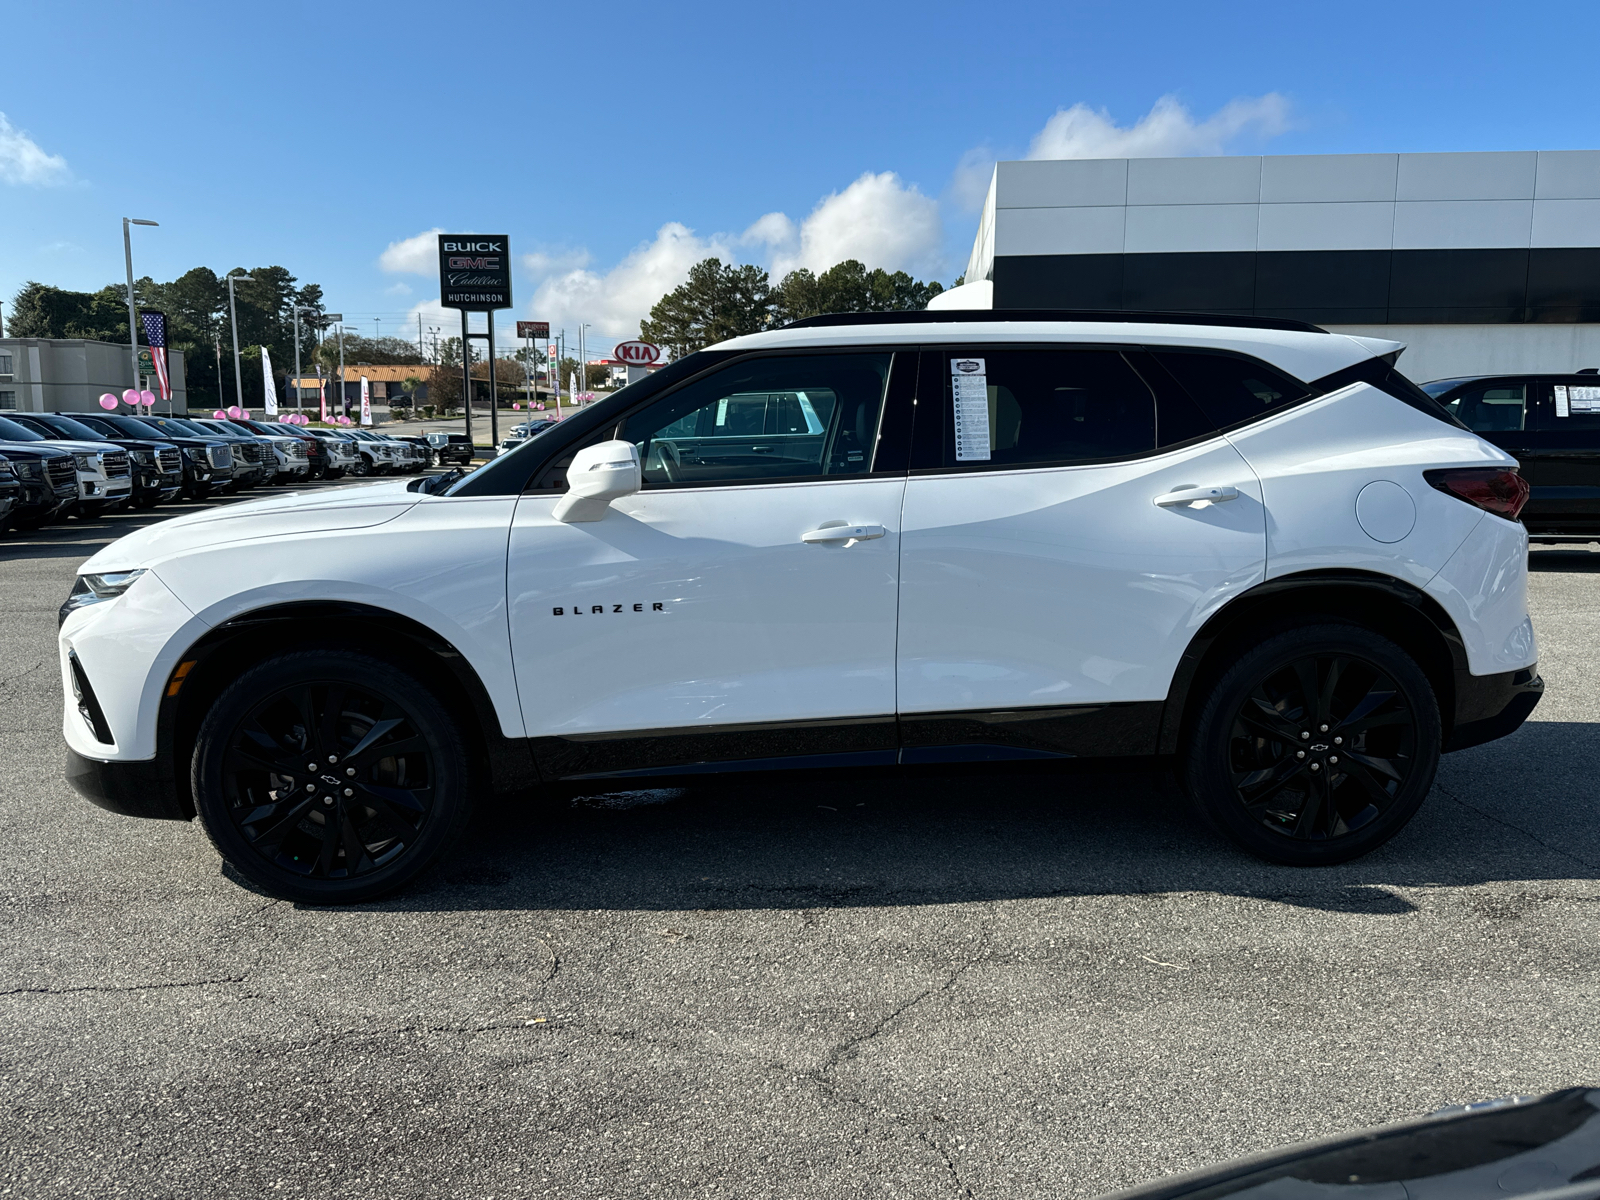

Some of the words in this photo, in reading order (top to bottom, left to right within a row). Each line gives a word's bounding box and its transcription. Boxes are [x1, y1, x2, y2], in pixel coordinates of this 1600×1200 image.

[444, 242, 502, 252] BUICK
[449, 256, 500, 270] GMC
[448, 271, 502, 287] Cadillac
[448, 293, 503, 302] HUTCHINSON
[622, 345, 653, 360] KIA
[552, 602, 663, 616] BLAZER
